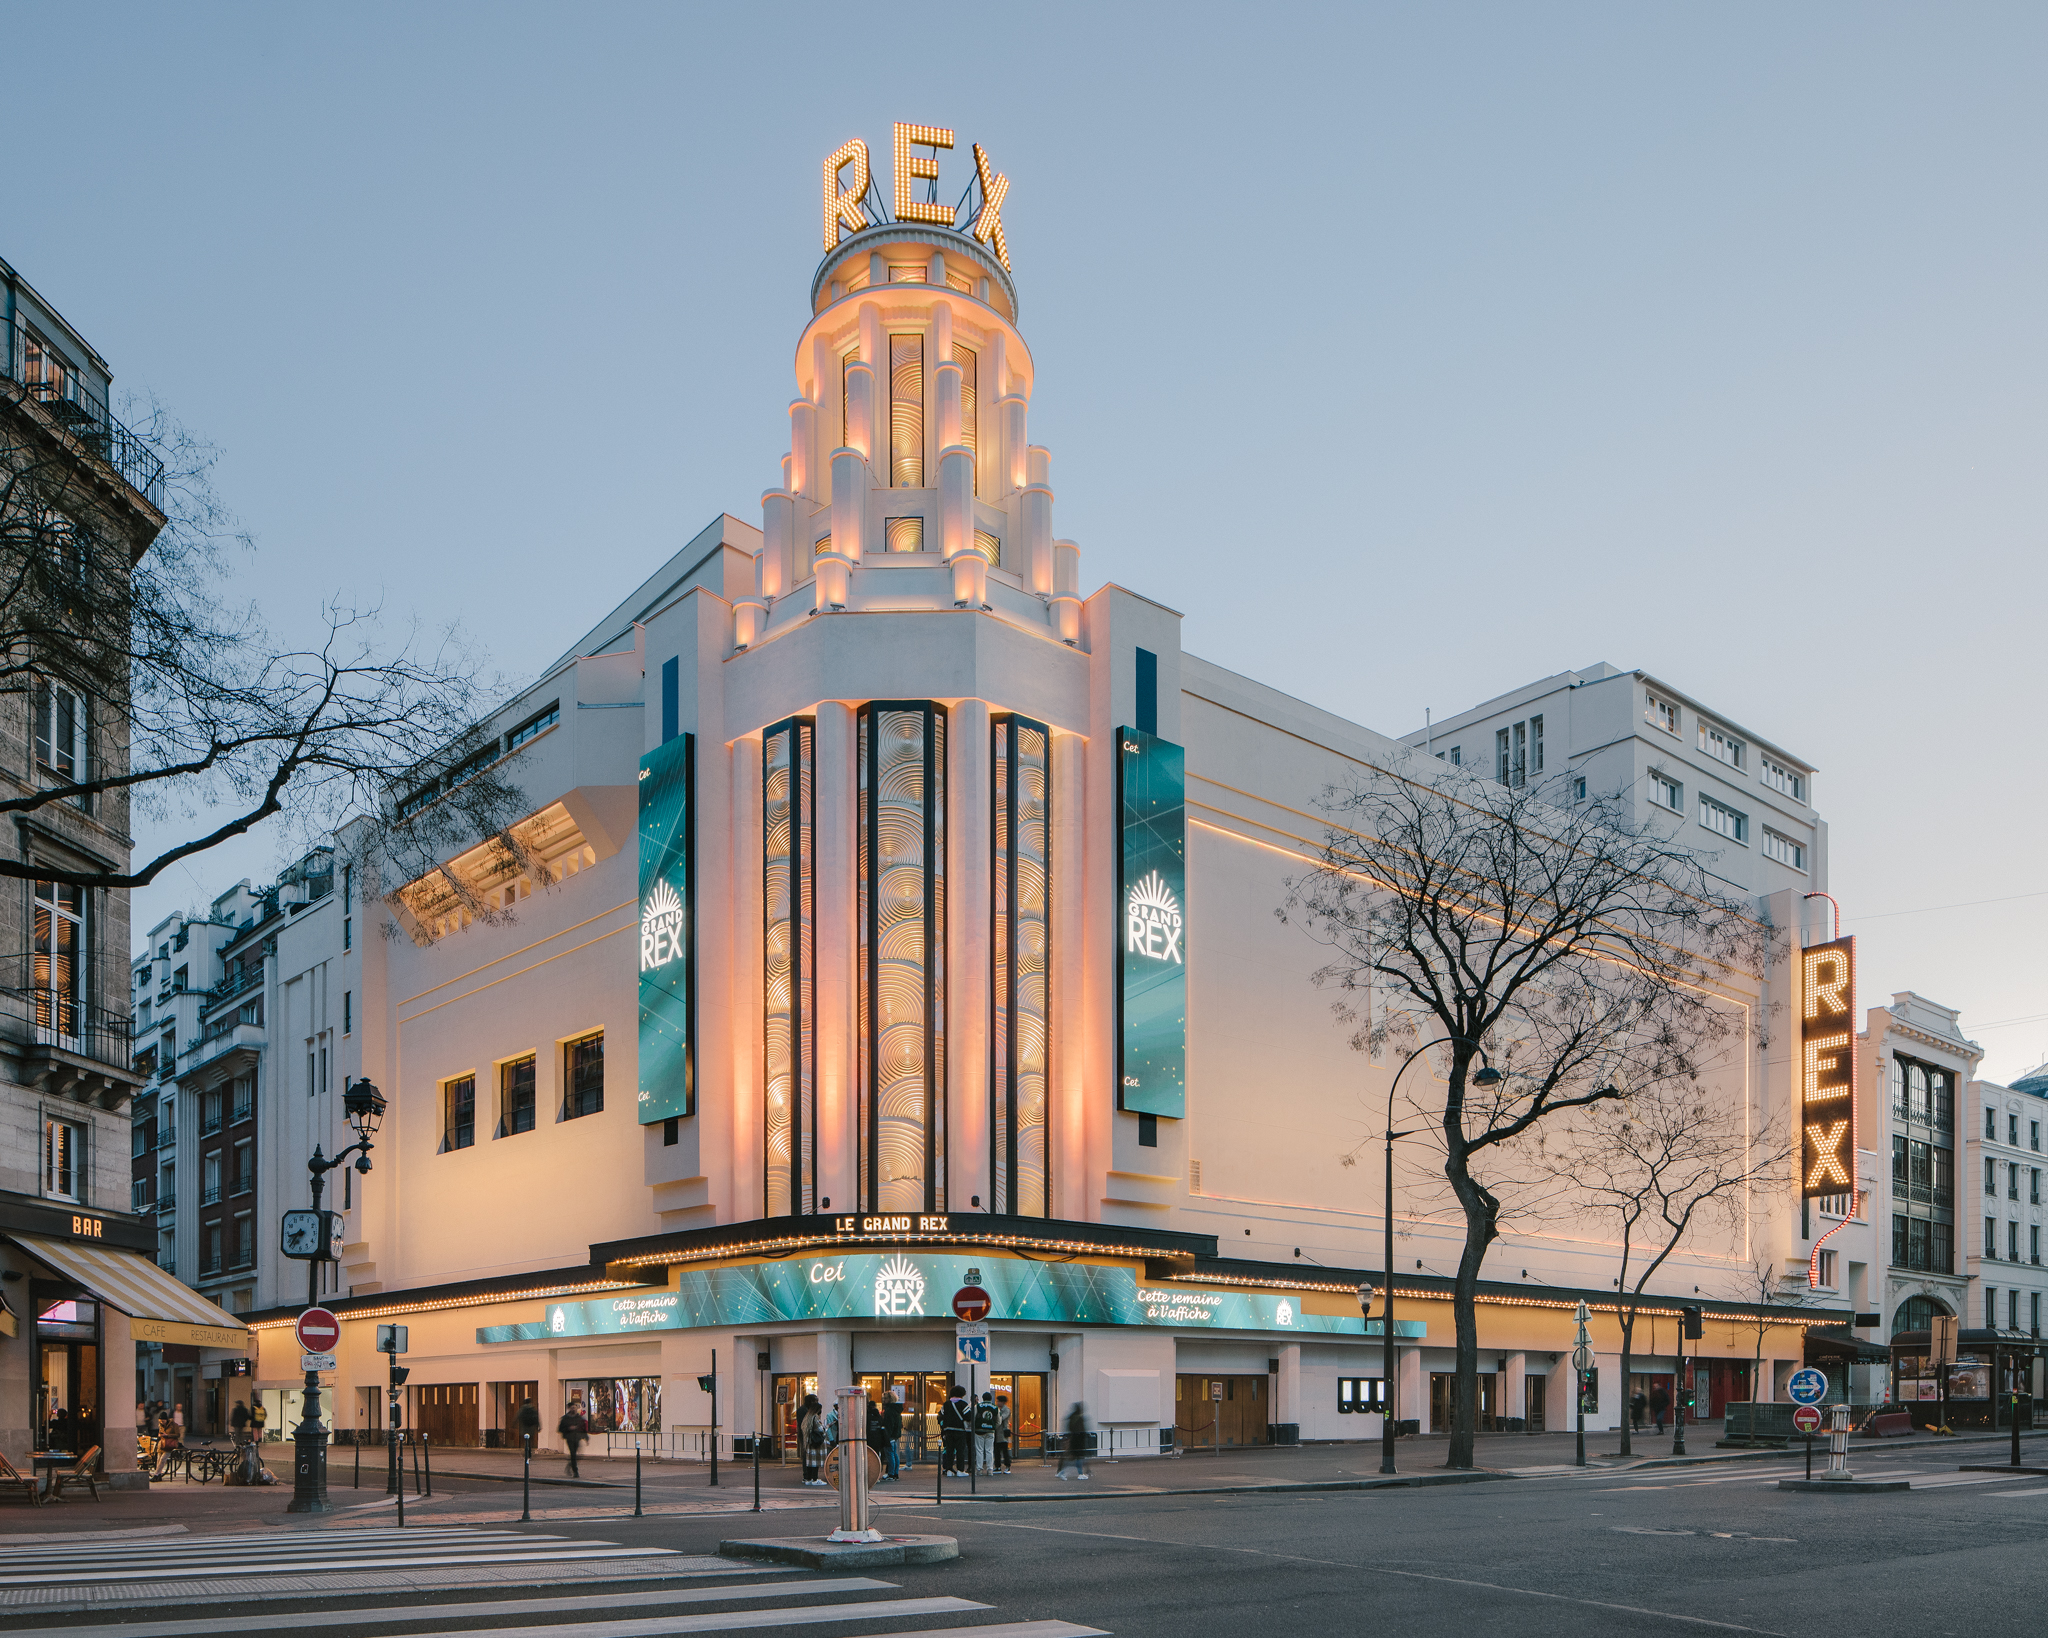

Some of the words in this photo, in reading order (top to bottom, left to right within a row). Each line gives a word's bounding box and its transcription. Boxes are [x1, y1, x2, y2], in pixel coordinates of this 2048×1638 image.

[823, 121, 1011, 273] REX
[641, 908, 683, 935] GRAND
[1128, 902, 1182, 928] GRAND
[641, 921, 683, 972] REX
[1128, 915, 1182, 964] REX
[1805, 950, 1850, 1188] REX
[72, 1215, 103, 1238] BAR
[836, 1218, 855, 1231] LE
[863, 1217, 911, 1231] GRAND
[919, 1217, 948, 1231] REX
[810, 1261, 846, 1283] Cet
[875, 1280, 925, 1290] GRAND
[612, 1298, 637, 1312] Cette
[637, 1296, 678, 1310] semaine
[875, 1289, 925, 1315] REX
[1137, 1289, 1170, 1303] Cette
[1171, 1293, 1223, 1306] semaine
[620, 1313, 629, 1326] à
[1147, 1305, 1159, 1318] à
[1276, 1313, 1293, 1326] REX
[143, 1324, 166, 1338] CAFE
[190, 1329, 238, 1344] RESTAURANT
[552, 1321, 565, 1333] REX
